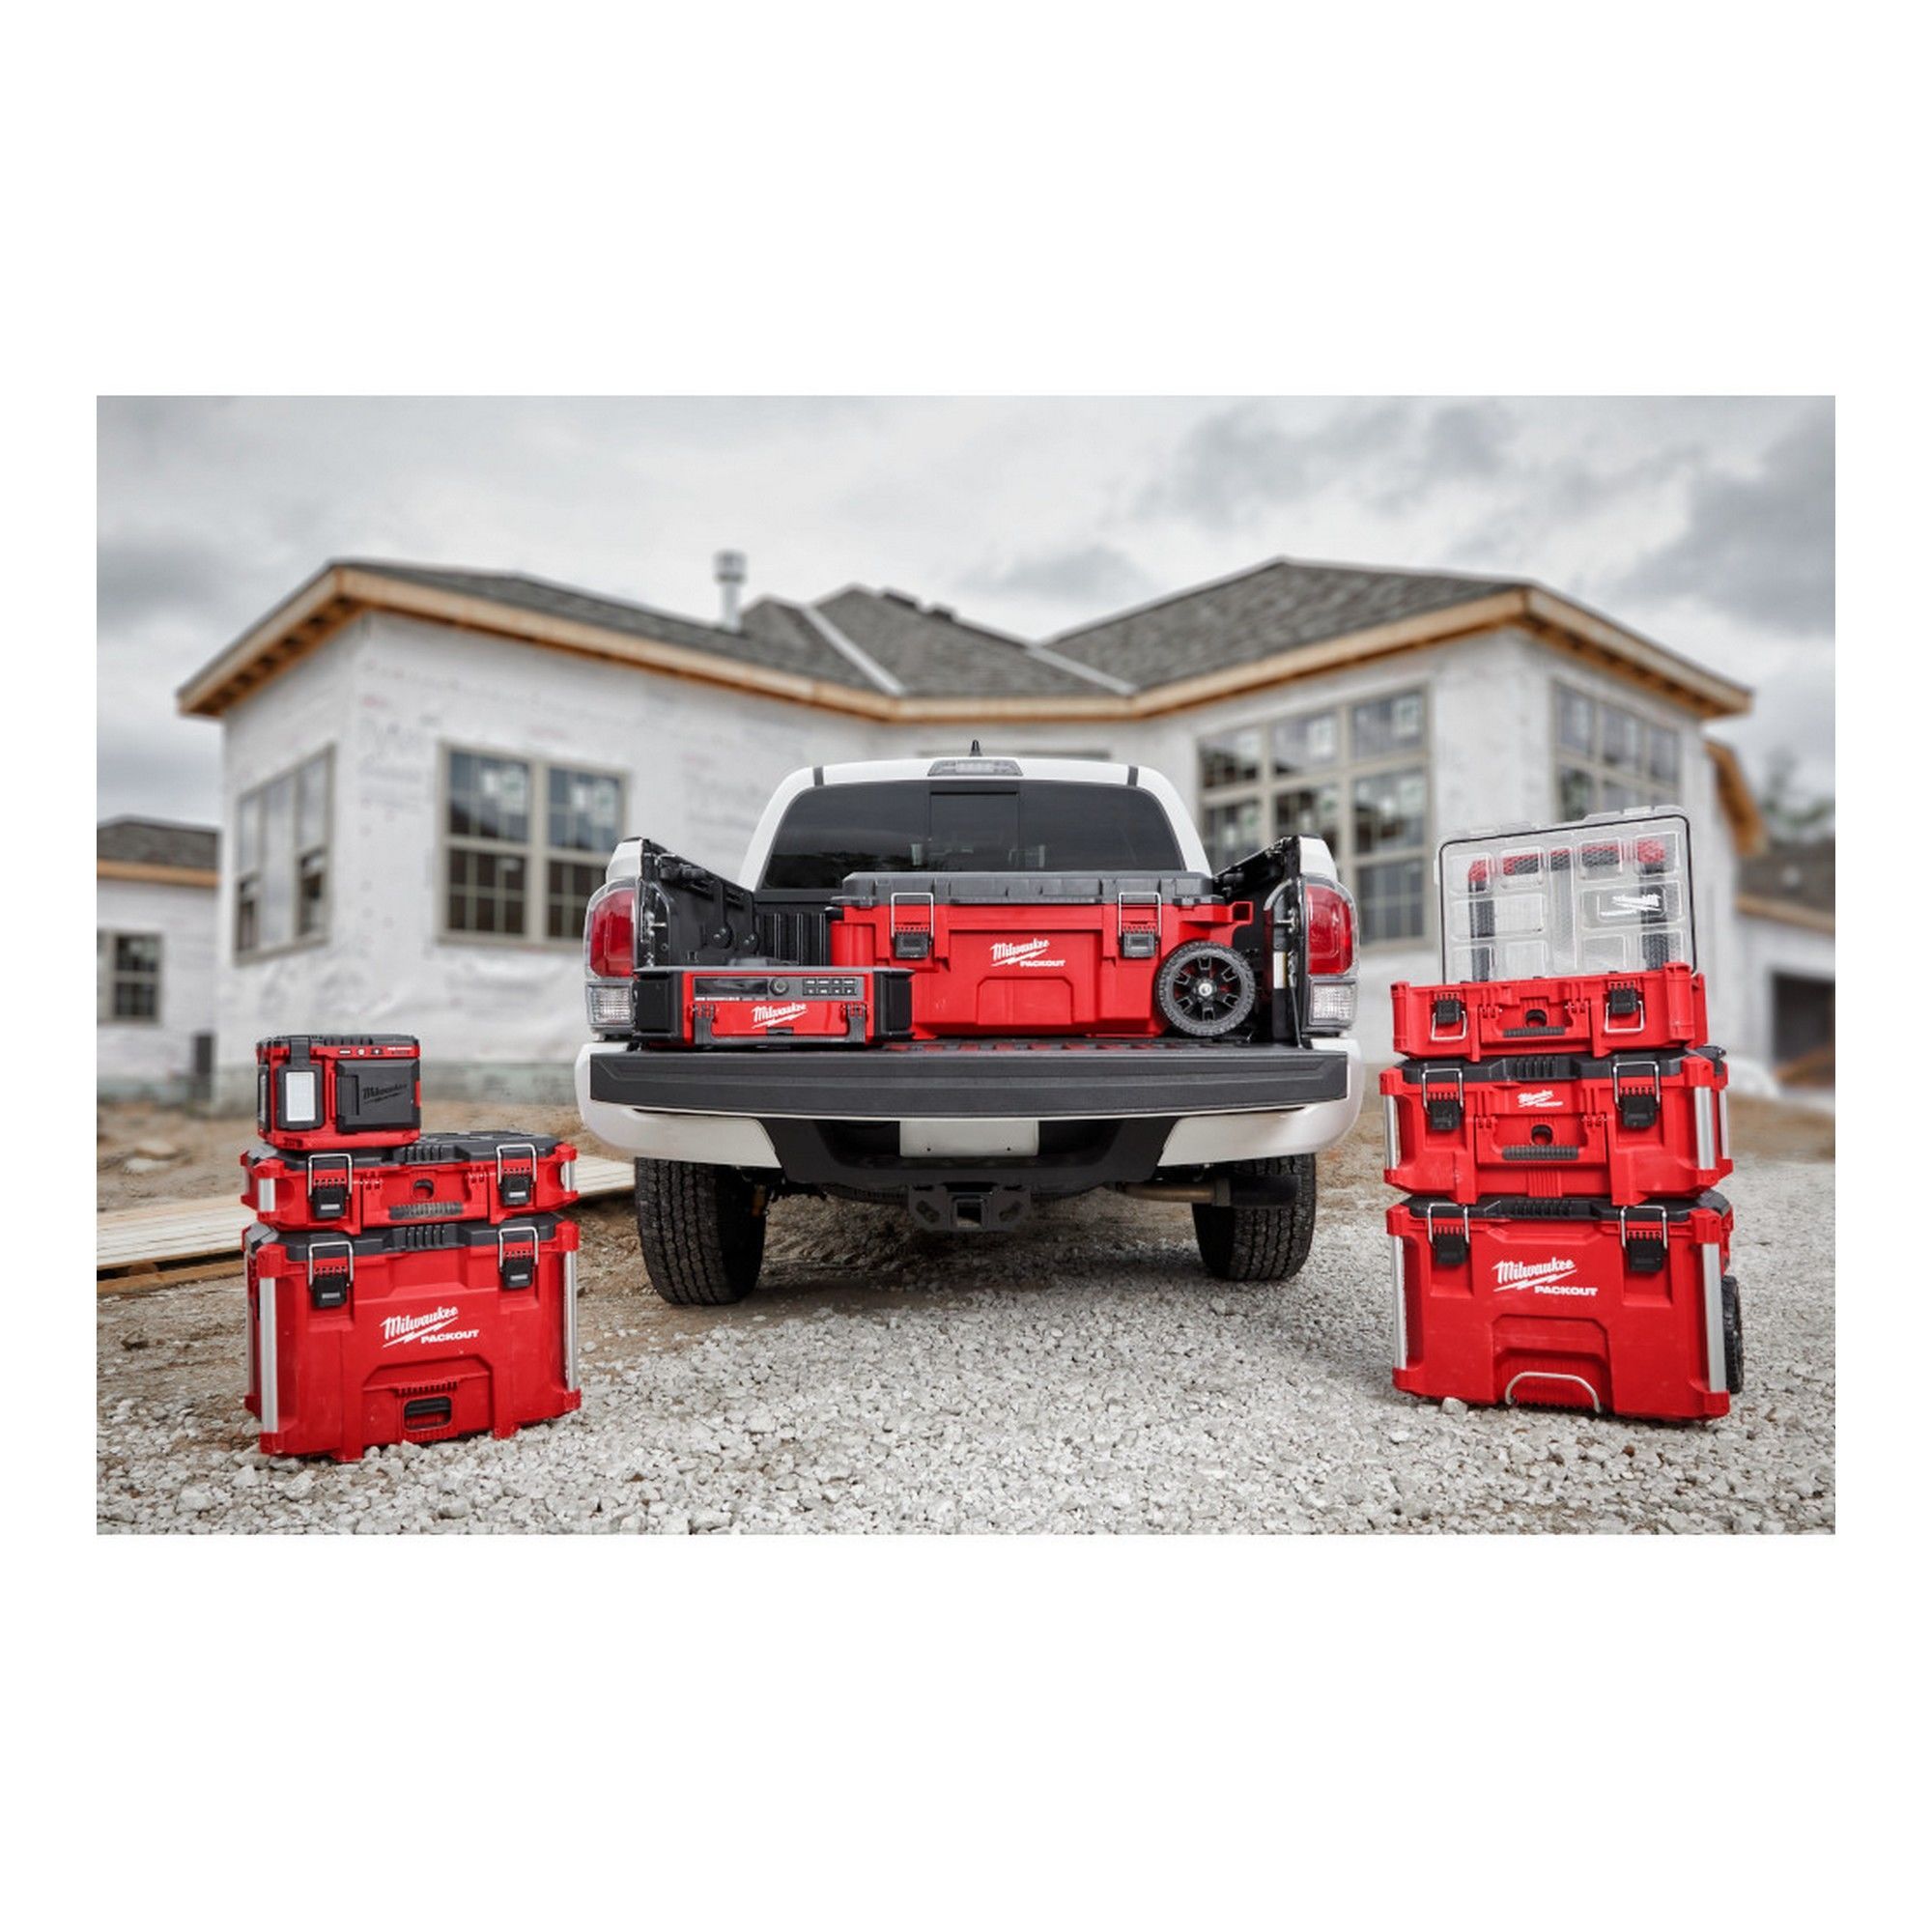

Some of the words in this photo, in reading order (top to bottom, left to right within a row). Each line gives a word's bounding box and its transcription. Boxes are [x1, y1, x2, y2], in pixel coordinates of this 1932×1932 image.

[990, 938, 1050, 960] Milwaukee
[1492, 1257, 1576, 1284] Milwaukee
[1534, 1286, 1598, 1296] PACKOUT
[380, 1306, 458, 1340] Milwaukee
[420, 1329, 479, 1344] PACKOUT
